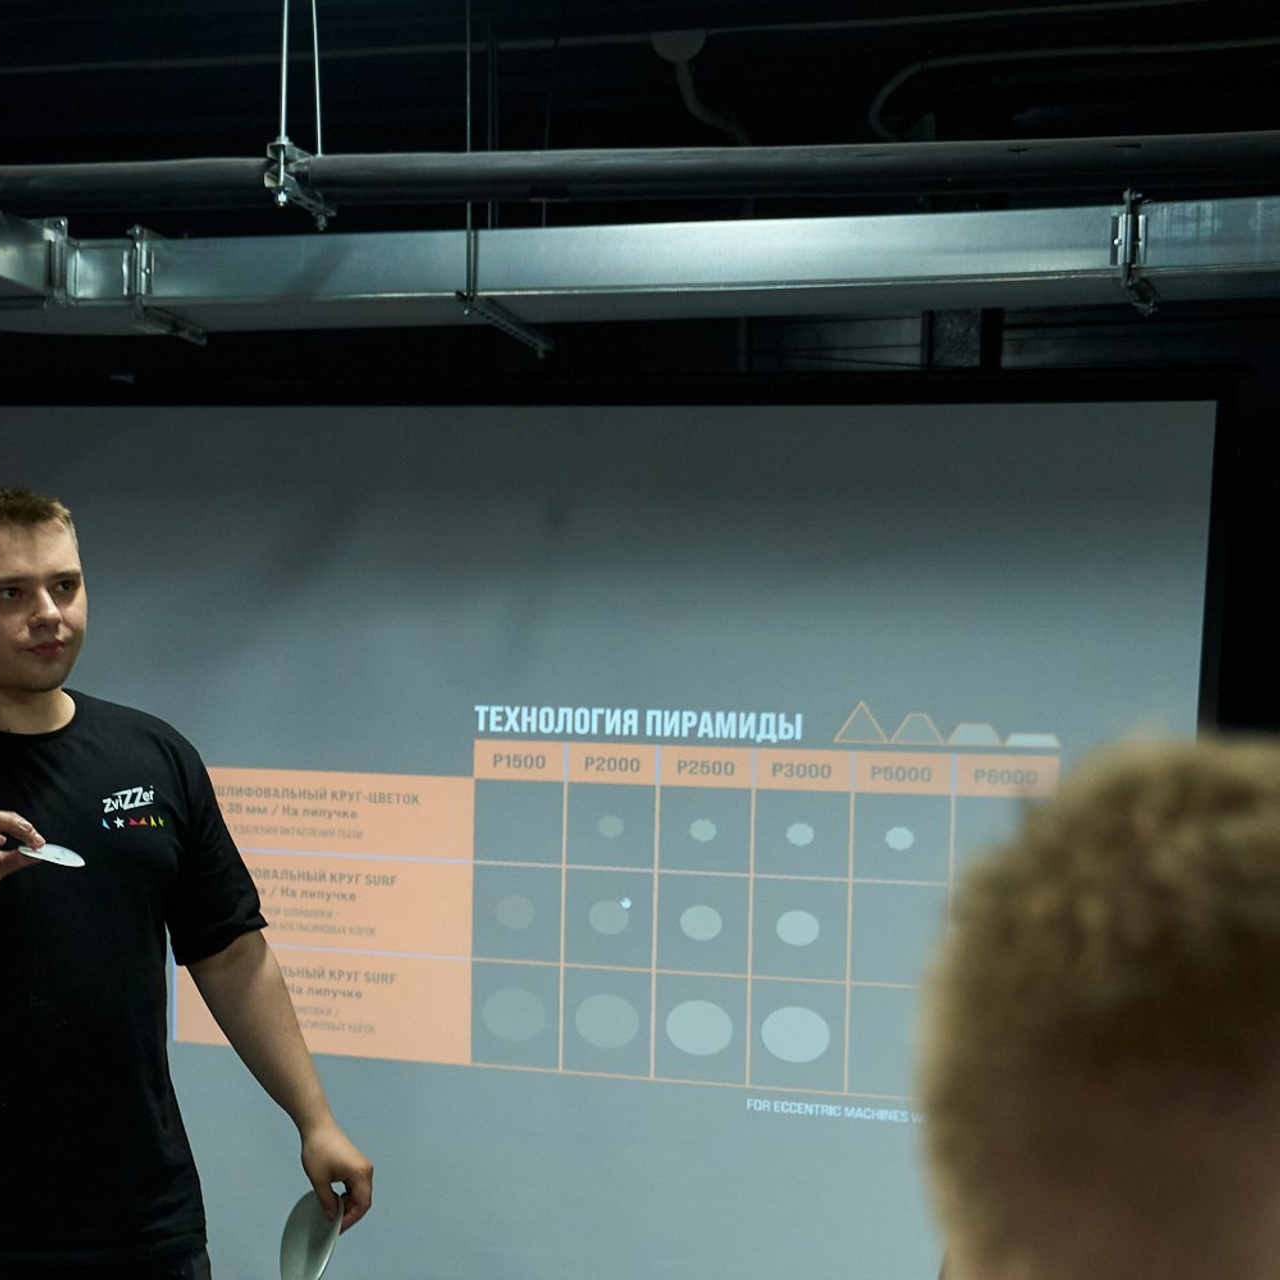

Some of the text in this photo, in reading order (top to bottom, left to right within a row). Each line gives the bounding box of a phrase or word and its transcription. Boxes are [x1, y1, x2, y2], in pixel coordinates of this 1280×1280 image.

[474, 704, 803, 743] ТЕХНОЛОГИЯ ПИРАМИДЫ
[493, 753, 1039, 786] P1500 P2000 P2500 P3000 P5000 P6000
[250, 868, 398, 887] ОВАЛЬНЫЙ КРУГ SURF
[329, 970, 360, 984] КРУГ
[364, 973, 397, 986] SURF
[746, 1098, 771, 1112] FOR
[773, 1100, 841, 1118] ECCENTRIC
[844, 1106, 909, 1123] MACHINES
